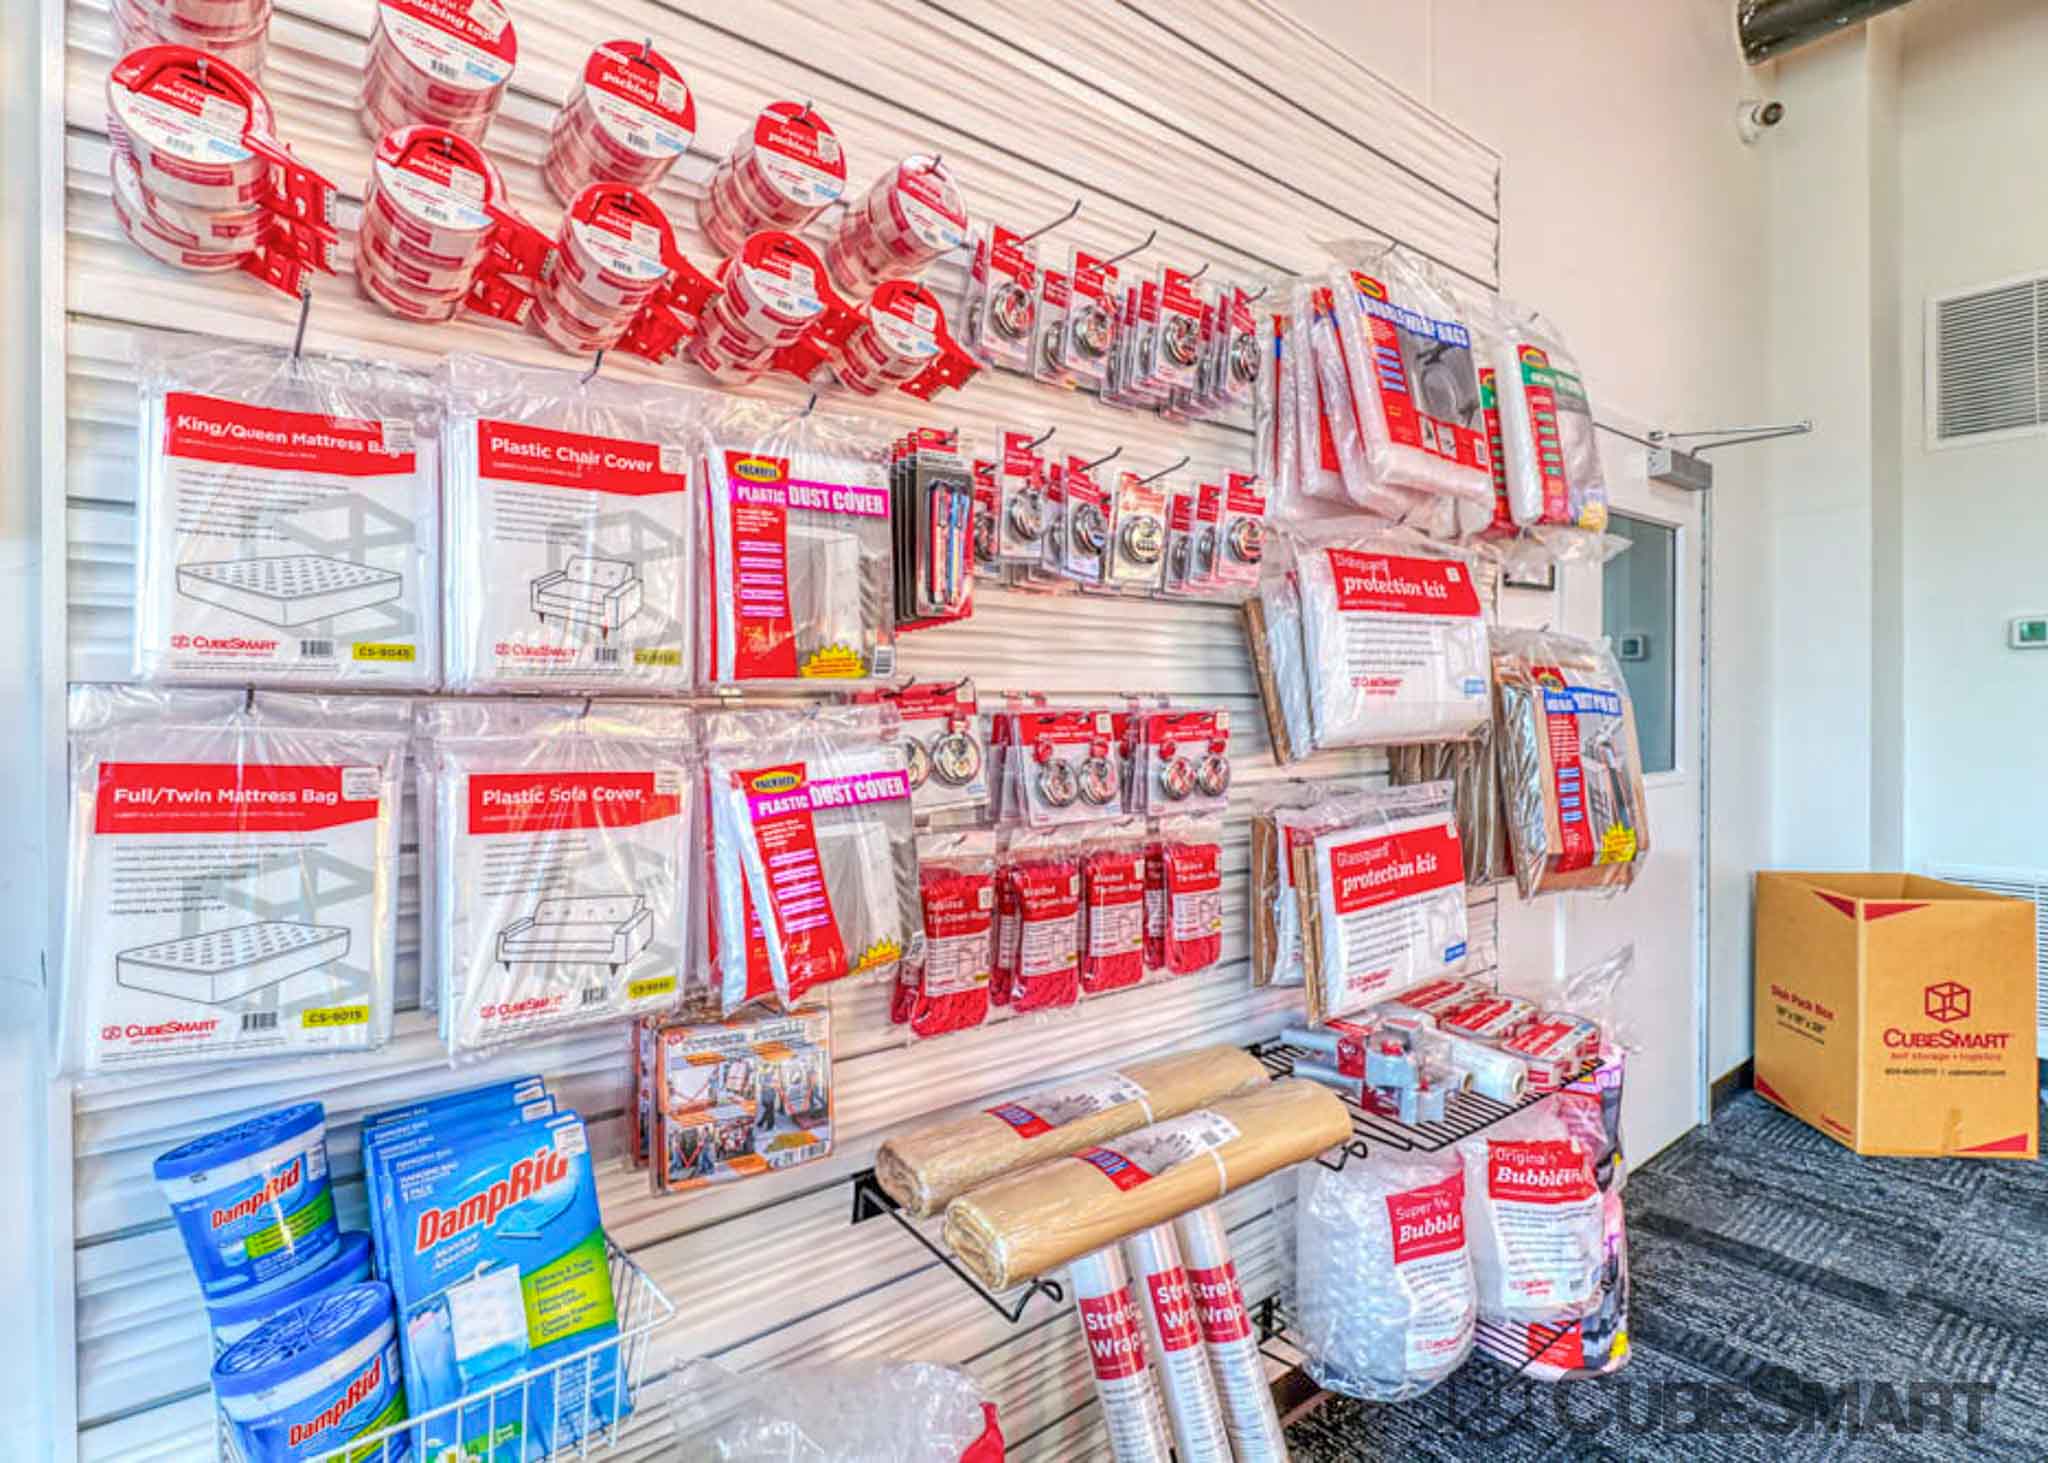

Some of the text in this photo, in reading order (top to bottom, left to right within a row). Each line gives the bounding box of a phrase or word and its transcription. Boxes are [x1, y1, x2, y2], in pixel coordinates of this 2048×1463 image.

[177, 415, 287, 444] King/Queen
[292, 432, 364, 453] Mattress
[491, 436, 552, 460] Plastic
[556, 446, 600, 466] Chair
[604, 453, 655, 474] Cover
[737, 485, 885, 514] PLASTIC DUST COVER
[1422, 579, 1449, 599] kit
[113, 787, 339, 806] Full/Twin Mattress Bag
[482, 785, 642, 806] Plastic Sofa Cover
[758, 777, 905, 816] PLASTIC DUST COVER
[1342, 853, 1438, 897] protection kit
[1496, 1148, 1546, 1167] Original
[211, 1158, 300, 1229] DampRid
[1395, 1203, 1431, 1223] Super
[1398, 1215, 1461, 1243] Bubble
[1092, 1332, 1141, 1358] Wrap
[289, 1356, 381, 1446] DampRid
